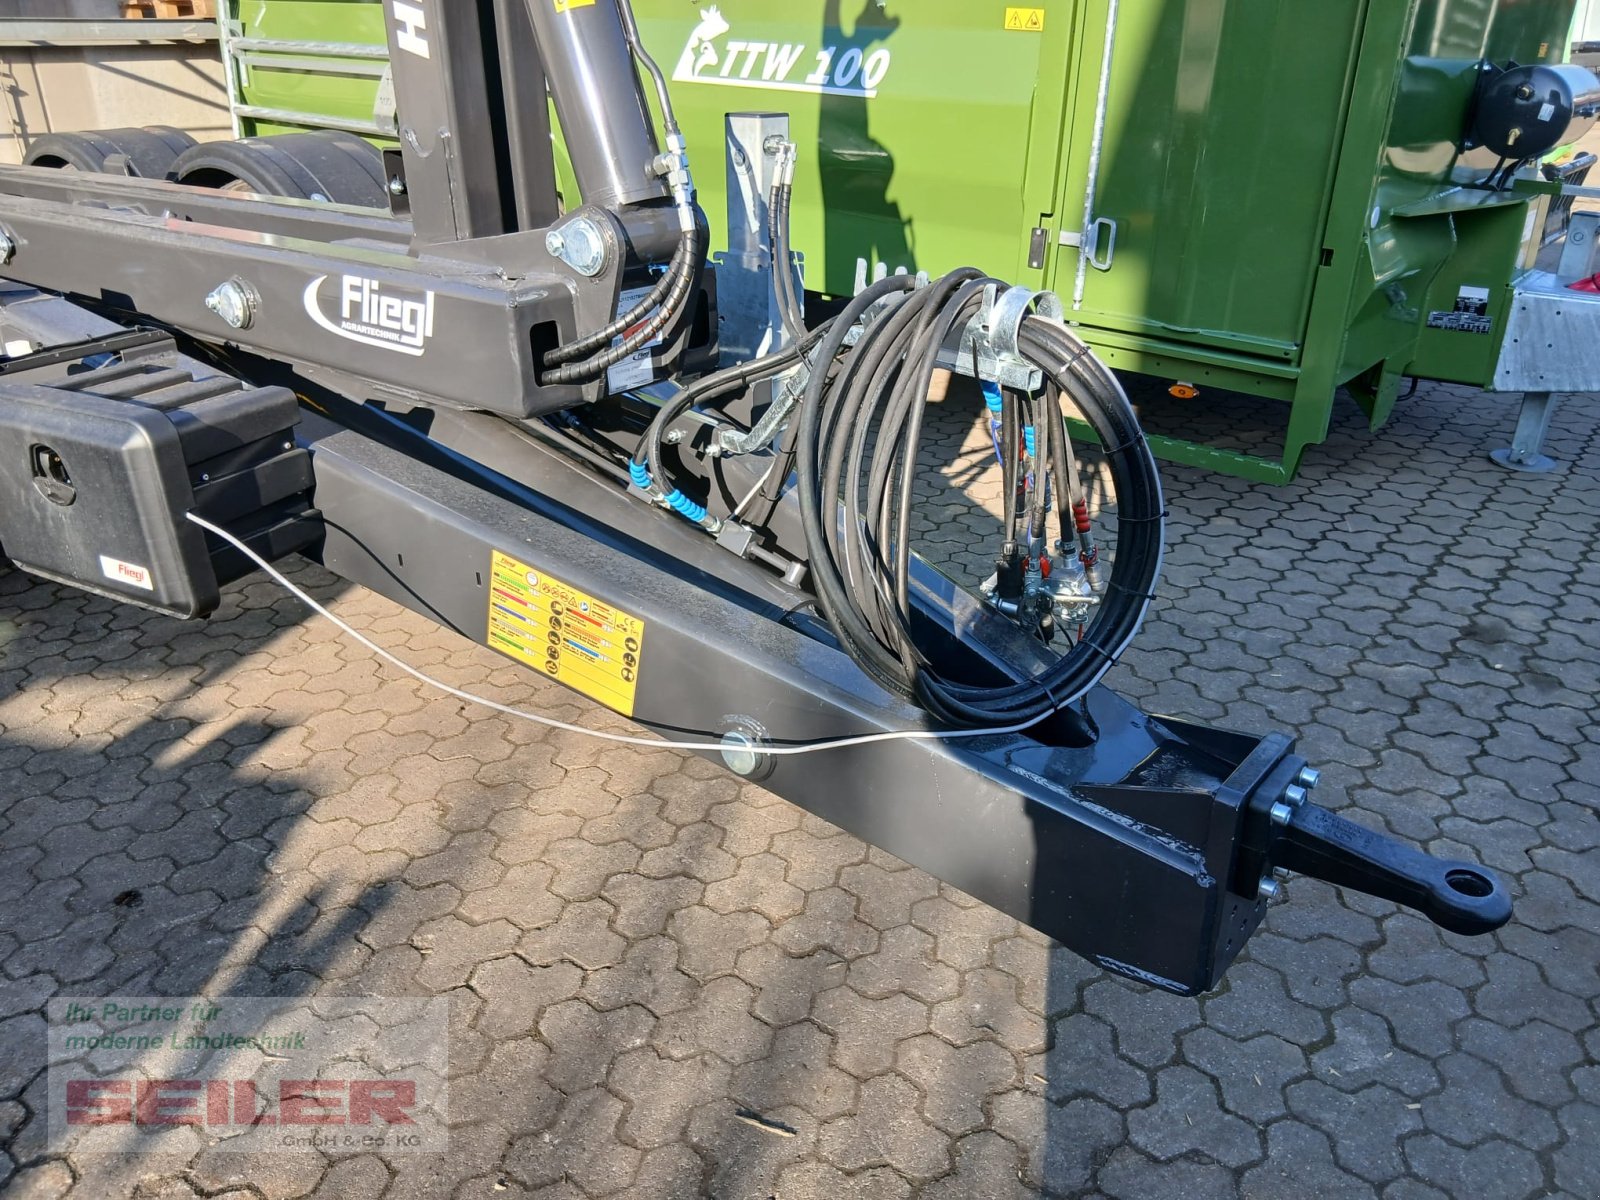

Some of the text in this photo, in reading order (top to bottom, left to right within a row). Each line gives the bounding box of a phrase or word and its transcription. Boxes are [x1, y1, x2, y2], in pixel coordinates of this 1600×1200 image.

[392, 0, 430, 59] H
[719, 41, 890, 89] TTW 100
[341, 321, 401, 342] AGRARTECHNIK
[342, 274, 434, 347] Fliegl
[118, 563, 144, 582] Fliegl
